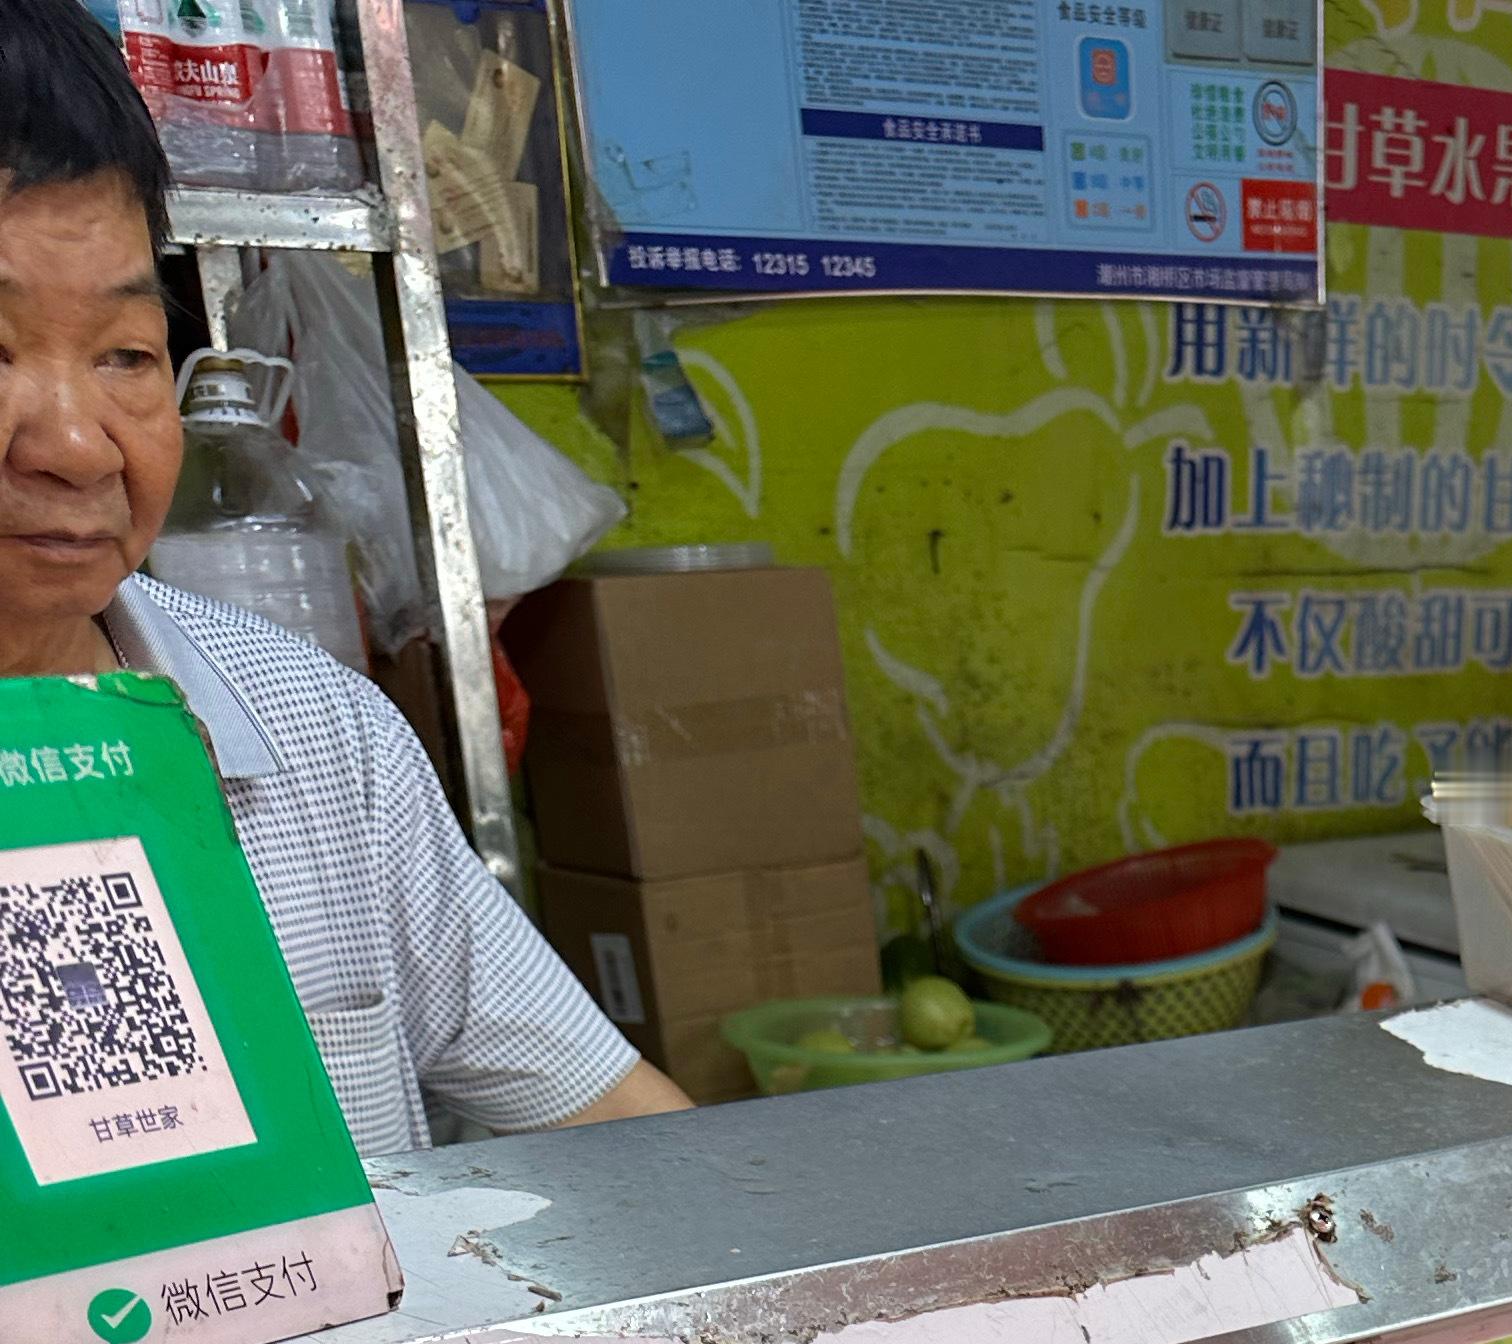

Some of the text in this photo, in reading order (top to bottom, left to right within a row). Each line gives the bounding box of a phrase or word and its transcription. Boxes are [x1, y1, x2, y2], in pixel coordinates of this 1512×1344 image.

[752, 253, 810, 276] 12315
[820, 256, 876, 278] 12345
[0, 739, 134, 787] 微信支付
[89, 1105, 184, 1143] 甘草世家
[161, 1251, 317, 1326] 微信支付
